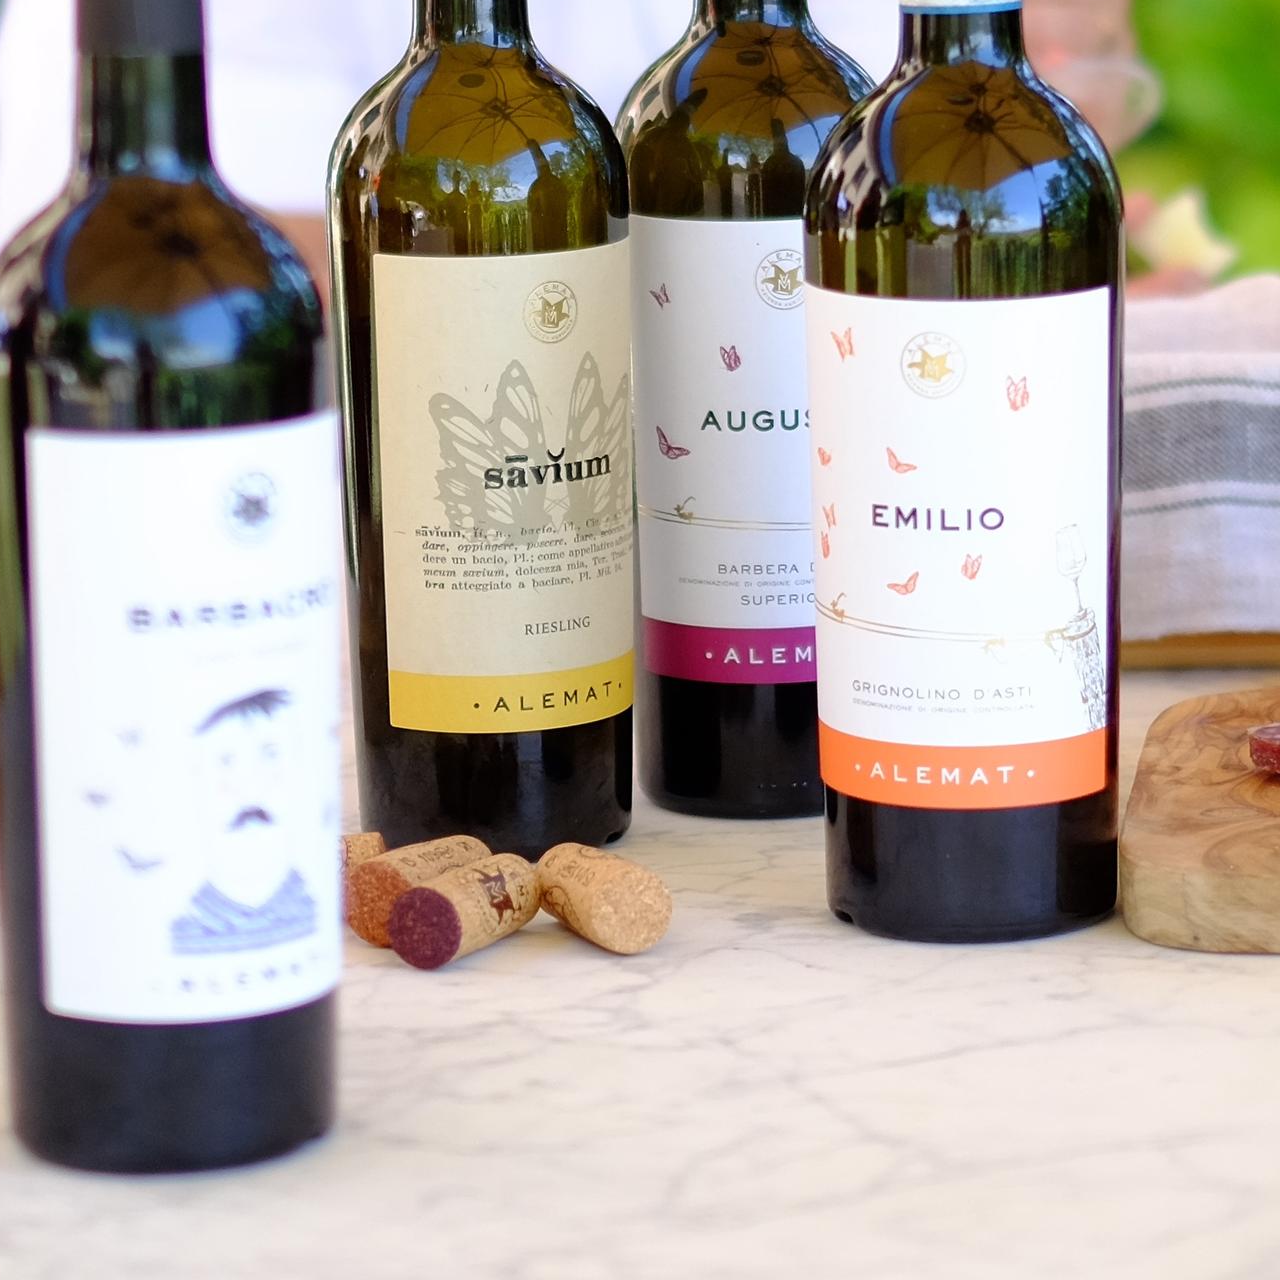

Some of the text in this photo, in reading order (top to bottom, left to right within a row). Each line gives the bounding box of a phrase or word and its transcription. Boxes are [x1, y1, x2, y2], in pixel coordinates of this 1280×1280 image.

[872, 503, 1005, 531] EMILIO
[452, 556, 466, 565] un
[718, 563, 799, 575] BARBERA
[525, 616, 591, 636] RIESLING
[723, 646, 812, 664] ALEM
[493, 681, 613, 712] ALEMAT
[852, 679, 1032, 701] GRIGNOLINO D'ASTI
[870, 762, 1014, 785] ALEMAT
